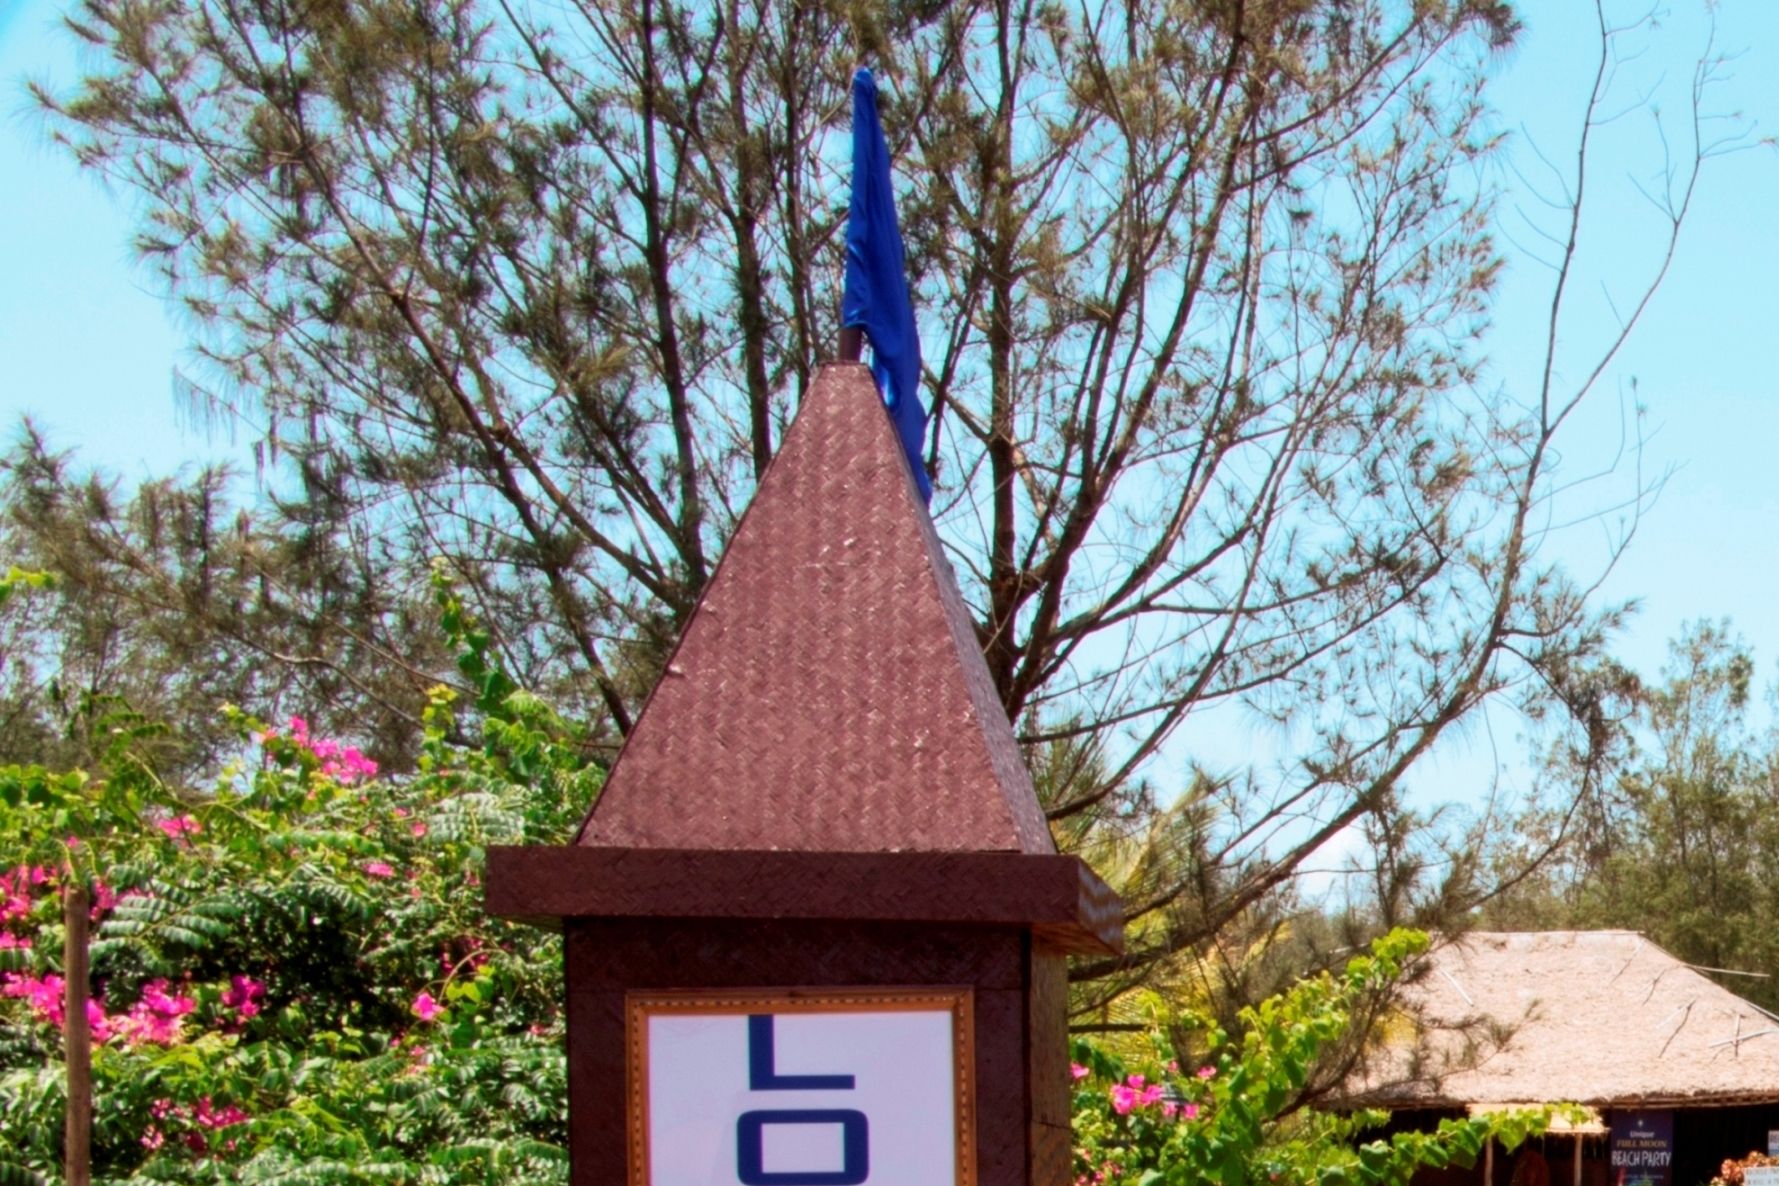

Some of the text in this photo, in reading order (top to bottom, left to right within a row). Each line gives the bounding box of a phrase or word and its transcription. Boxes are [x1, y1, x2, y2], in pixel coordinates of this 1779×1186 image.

[1616, 1140, 1667, 1148] FULL MOON
[1611, 1150, 1672, 1167] BEACH PARTY
